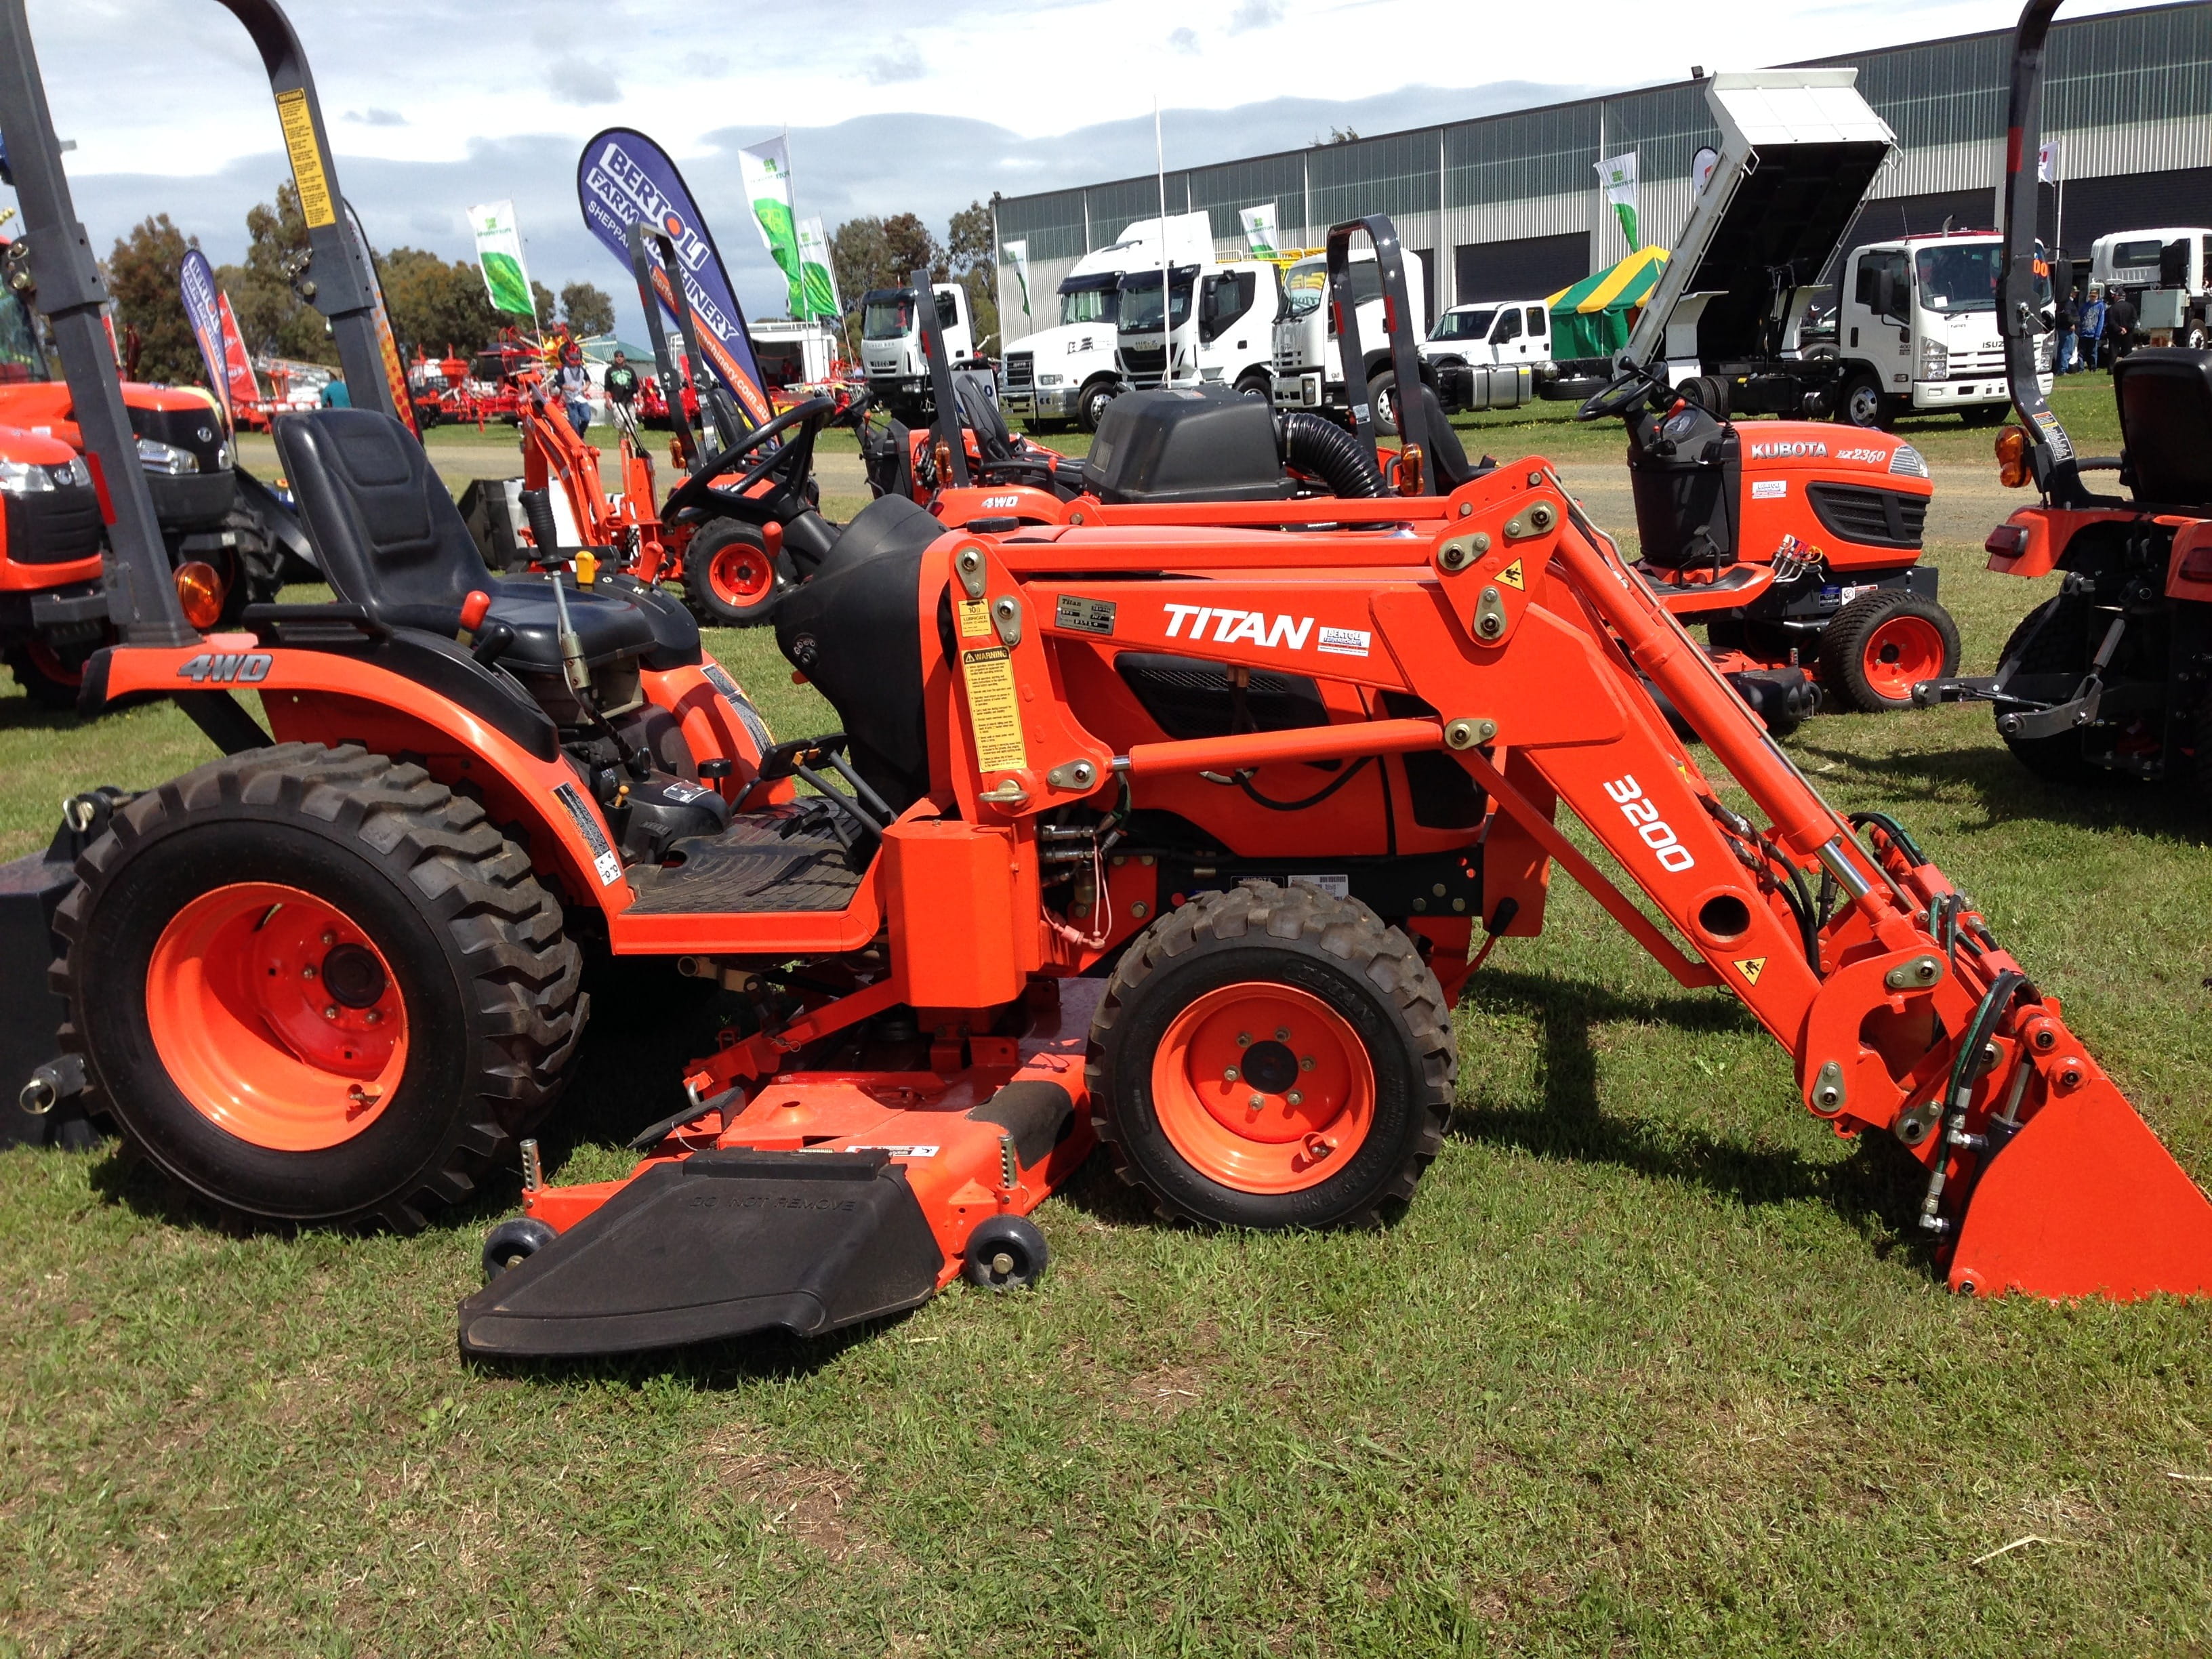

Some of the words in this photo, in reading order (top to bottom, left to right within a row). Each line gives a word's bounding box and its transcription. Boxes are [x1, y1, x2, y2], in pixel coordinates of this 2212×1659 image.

[586, 167, 640, 224] FARM
[599, 143, 710, 271] BERTOLI
[588, 201, 629, 248] SHEPPA
[1750, 441, 1828, 460] KUBOTA
[1835, 448, 1887, 464] BX2360
[981, 495, 1019, 508] 4WD
[1062, 598, 1082, 607] Titan
[1164, 603, 1315, 650] TITAN
[177, 653, 273, 682] 4WD
[975, 650, 1008, 660] WARNING
[1603, 774, 1695, 872] 3200
[689, 1196, 719, 1208] DO
[728, 1197, 769, 1209] NOT
[773, 1197, 858, 1212] REMOVE
